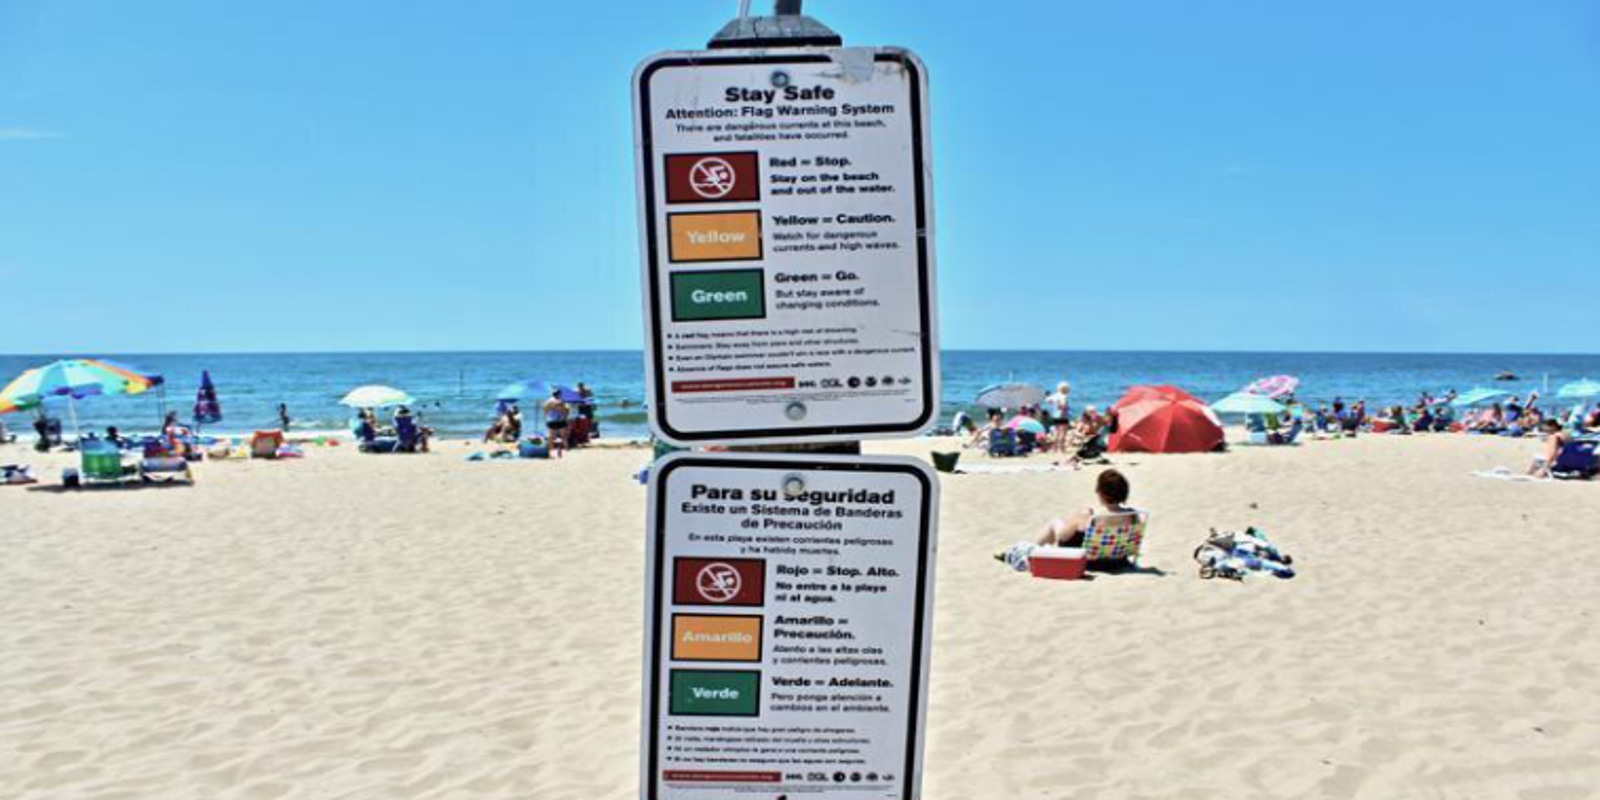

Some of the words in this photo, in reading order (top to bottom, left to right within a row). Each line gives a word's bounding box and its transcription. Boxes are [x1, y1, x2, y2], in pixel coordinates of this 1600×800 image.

[725, 86, 776, 104] Stay
[783, 85, 835, 101] Safe
[665, 107, 738, 119] Attention:
[741, 106, 774, 119] Flag
[776, 105, 838, 117] Warning
[841, 103, 895, 117] System
[676, 124, 704, 133] There
[724, 122, 777, 132] dangerous
[779, 121, 820, 130] currents
[821, 120, 831, 128] at
[833, 120, 852, 128] this
[854, 119, 886, 128] beach,
[713, 134, 733, 142] and
[734, 133, 776, 141] fatalities
[778, 132, 802, 140] have
[804, 130, 848, 140] occurred.
[769, 157, 797, 168] Red
[815, 156, 852, 168] Stop.
[770, 174, 797, 184] Stay
[800, 175, 817, 183] on
[819, 173, 840, 182] the
[842, 172, 880, 181] beach
[770, 186, 794, 196] and
[796, 186, 817, 195] out
[819, 185, 833, 194] of
[835, 185, 856, 194] the
[858, 184, 895, 193] water.
[772, 215, 819, 226] Yellow
[835, 213, 896, 224] Caution.
[686, 230, 745, 244] Yellow
[772, 232, 804, 241] Watch
[806, 231, 820, 240] for
[823, 231, 878, 241] dangerous
[772, 243, 816, 252] currents
[816, 242, 838, 251] and
[839, 242, 863, 252] high
[865, 241, 901, 250] waves.
[774, 272, 818, 283] Green
[835, 270, 859, 282] Go.
[691, 289, 748, 303] Green
[775, 289, 794, 298] But
[795, 289, 818, 298] stay
[820, 289, 852, 297] aware
[853, 287, 865, 296] of
[775, 301, 824, 311] changing
[825, 298, 880, 308] conditions.
[691, 484, 743, 501] Para
[750, 489, 777, 501] su
[681, 502, 726, 514] Existe
[729, 506, 748, 514] un
[751, 504, 810, 516] Sistema
[813, 506, 832, 517] de
[835, 506, 903, 519] Banderas
[740, 517, 760, 529] de
[763, 518, 843, 531] Precaución
[776, 564, 809, 578] Rojo
[826, 565, 863, 578] Stop.
[866, 566, 900, 577] Alto.
[775, 581, 793, 591] No
[795, 582, 827, 591] entre
[841, 582, 852, 592] la
[854, 583, 887, 594] playa
[774, 593, 787, 602] ni
[789, 593, 801, 602] al
[804, 595, 836, 604] agua.
[774, 615, 835, 626] Amarillo
[682, 630, 752, 644] Amarillo
[773, 628, 855, 640] Precaución.
[772, 676, 811, 687] Verde
[828, 677, 894, 688] Adelante.
[692, 687, 739, 699] Verde
[770, 703, 813, 712] cambios
[830, 704, 840, 712] el
[842, 704, 890, 713] ambiente.
